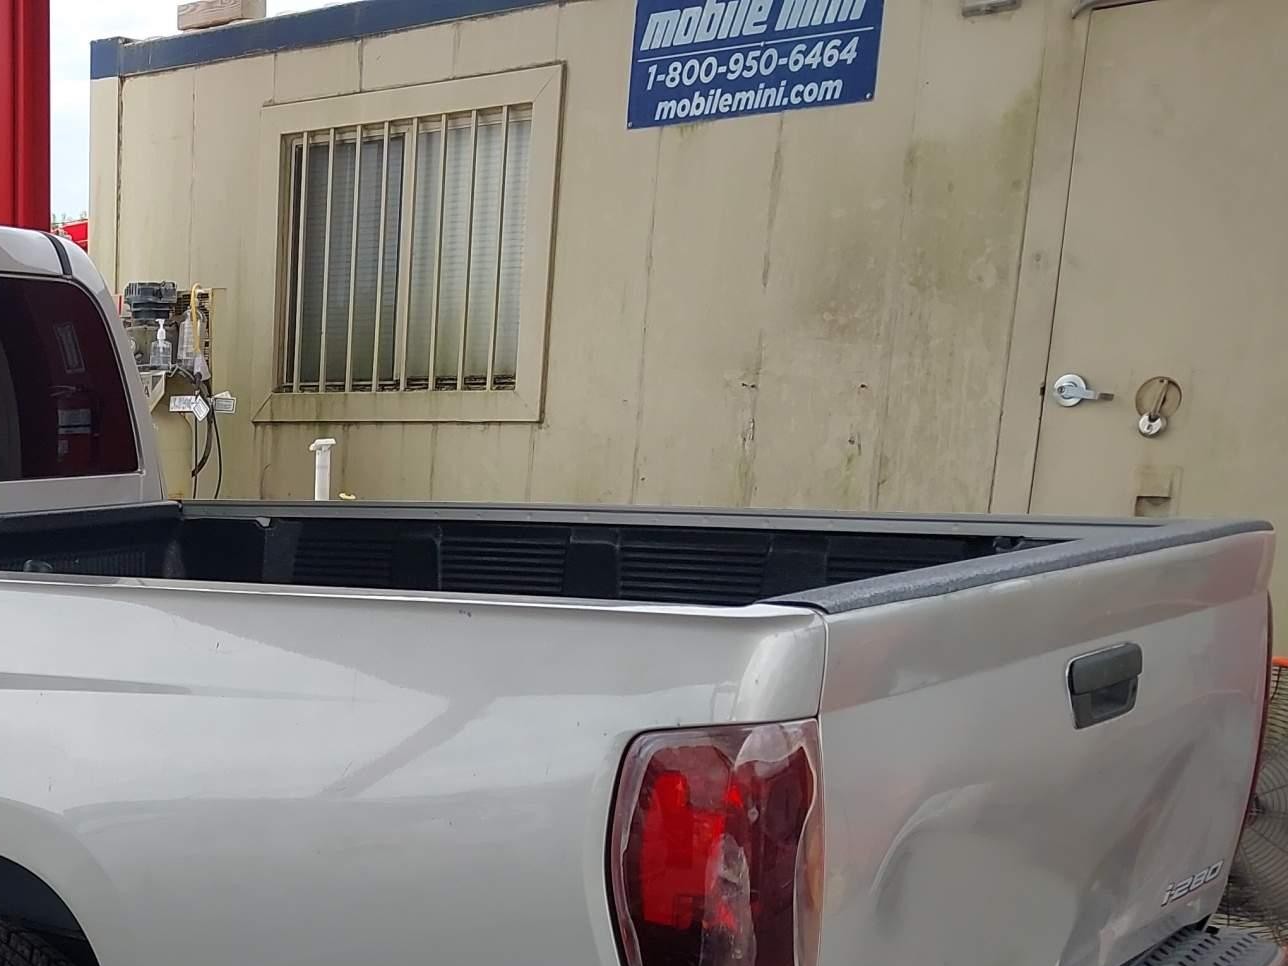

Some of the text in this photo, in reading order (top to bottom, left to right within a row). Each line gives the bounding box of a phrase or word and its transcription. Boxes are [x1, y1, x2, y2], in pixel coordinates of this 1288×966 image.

[640, 0, 772, 51] mobile
[646, 36, 859, 91] 1-800-950-6464
[654, 79, 843, 121] mobilemini.com
